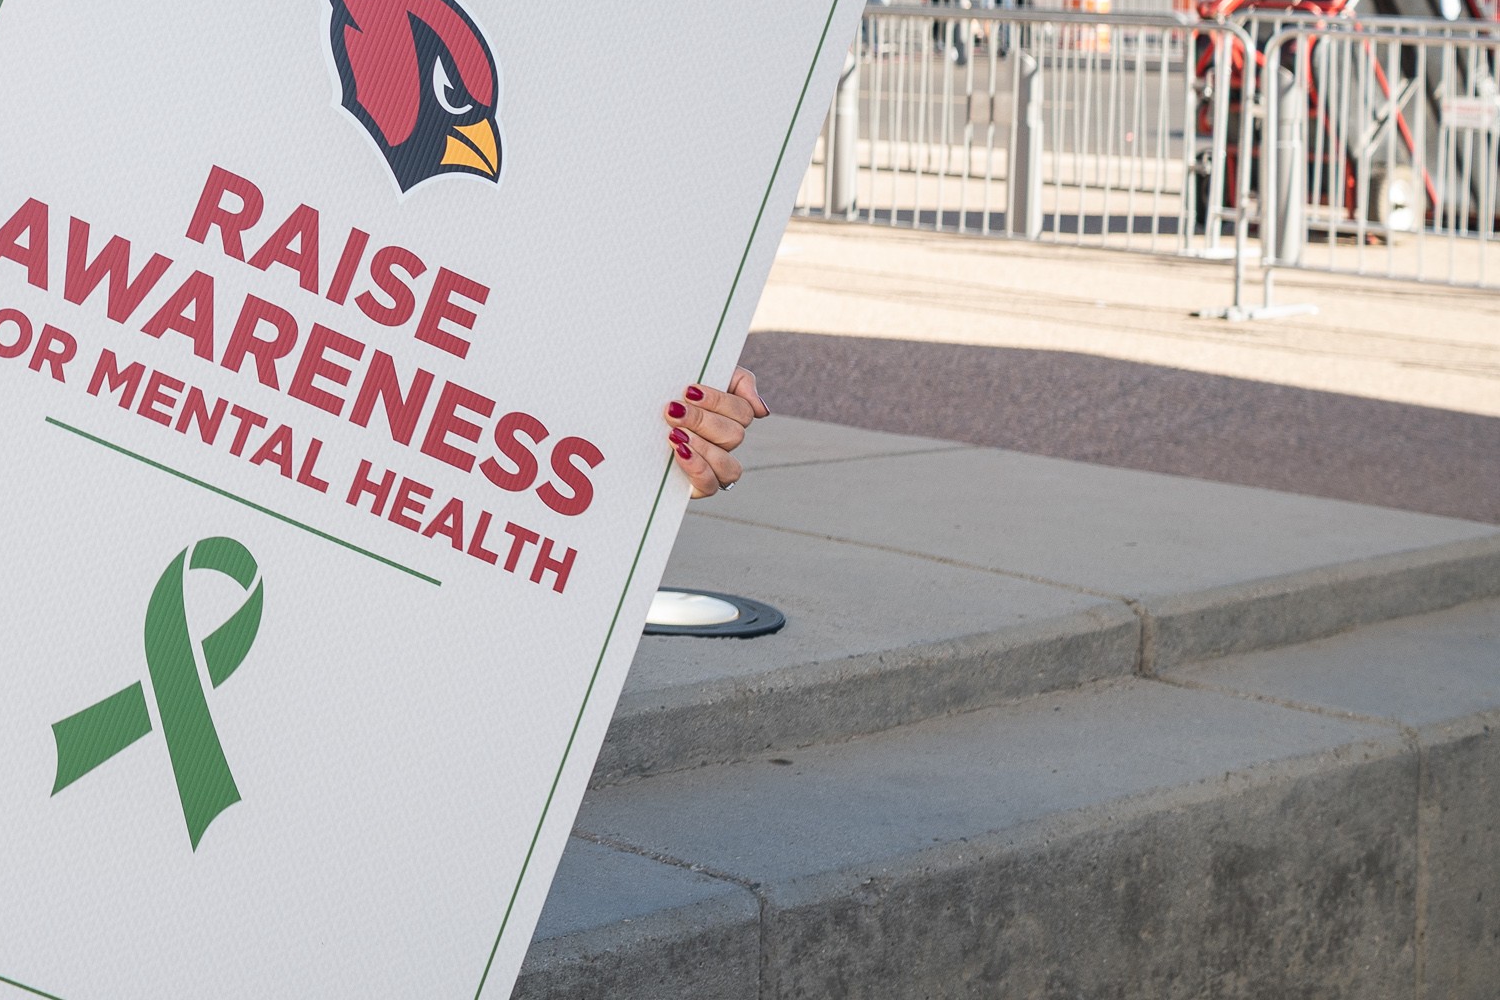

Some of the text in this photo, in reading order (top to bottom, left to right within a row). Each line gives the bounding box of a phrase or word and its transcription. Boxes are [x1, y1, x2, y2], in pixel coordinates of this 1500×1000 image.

[185, 164, 490, 360] RAISE
[86, 348, 329, 493] MENTAL
[346, 459, 578, 594] HEALTH
